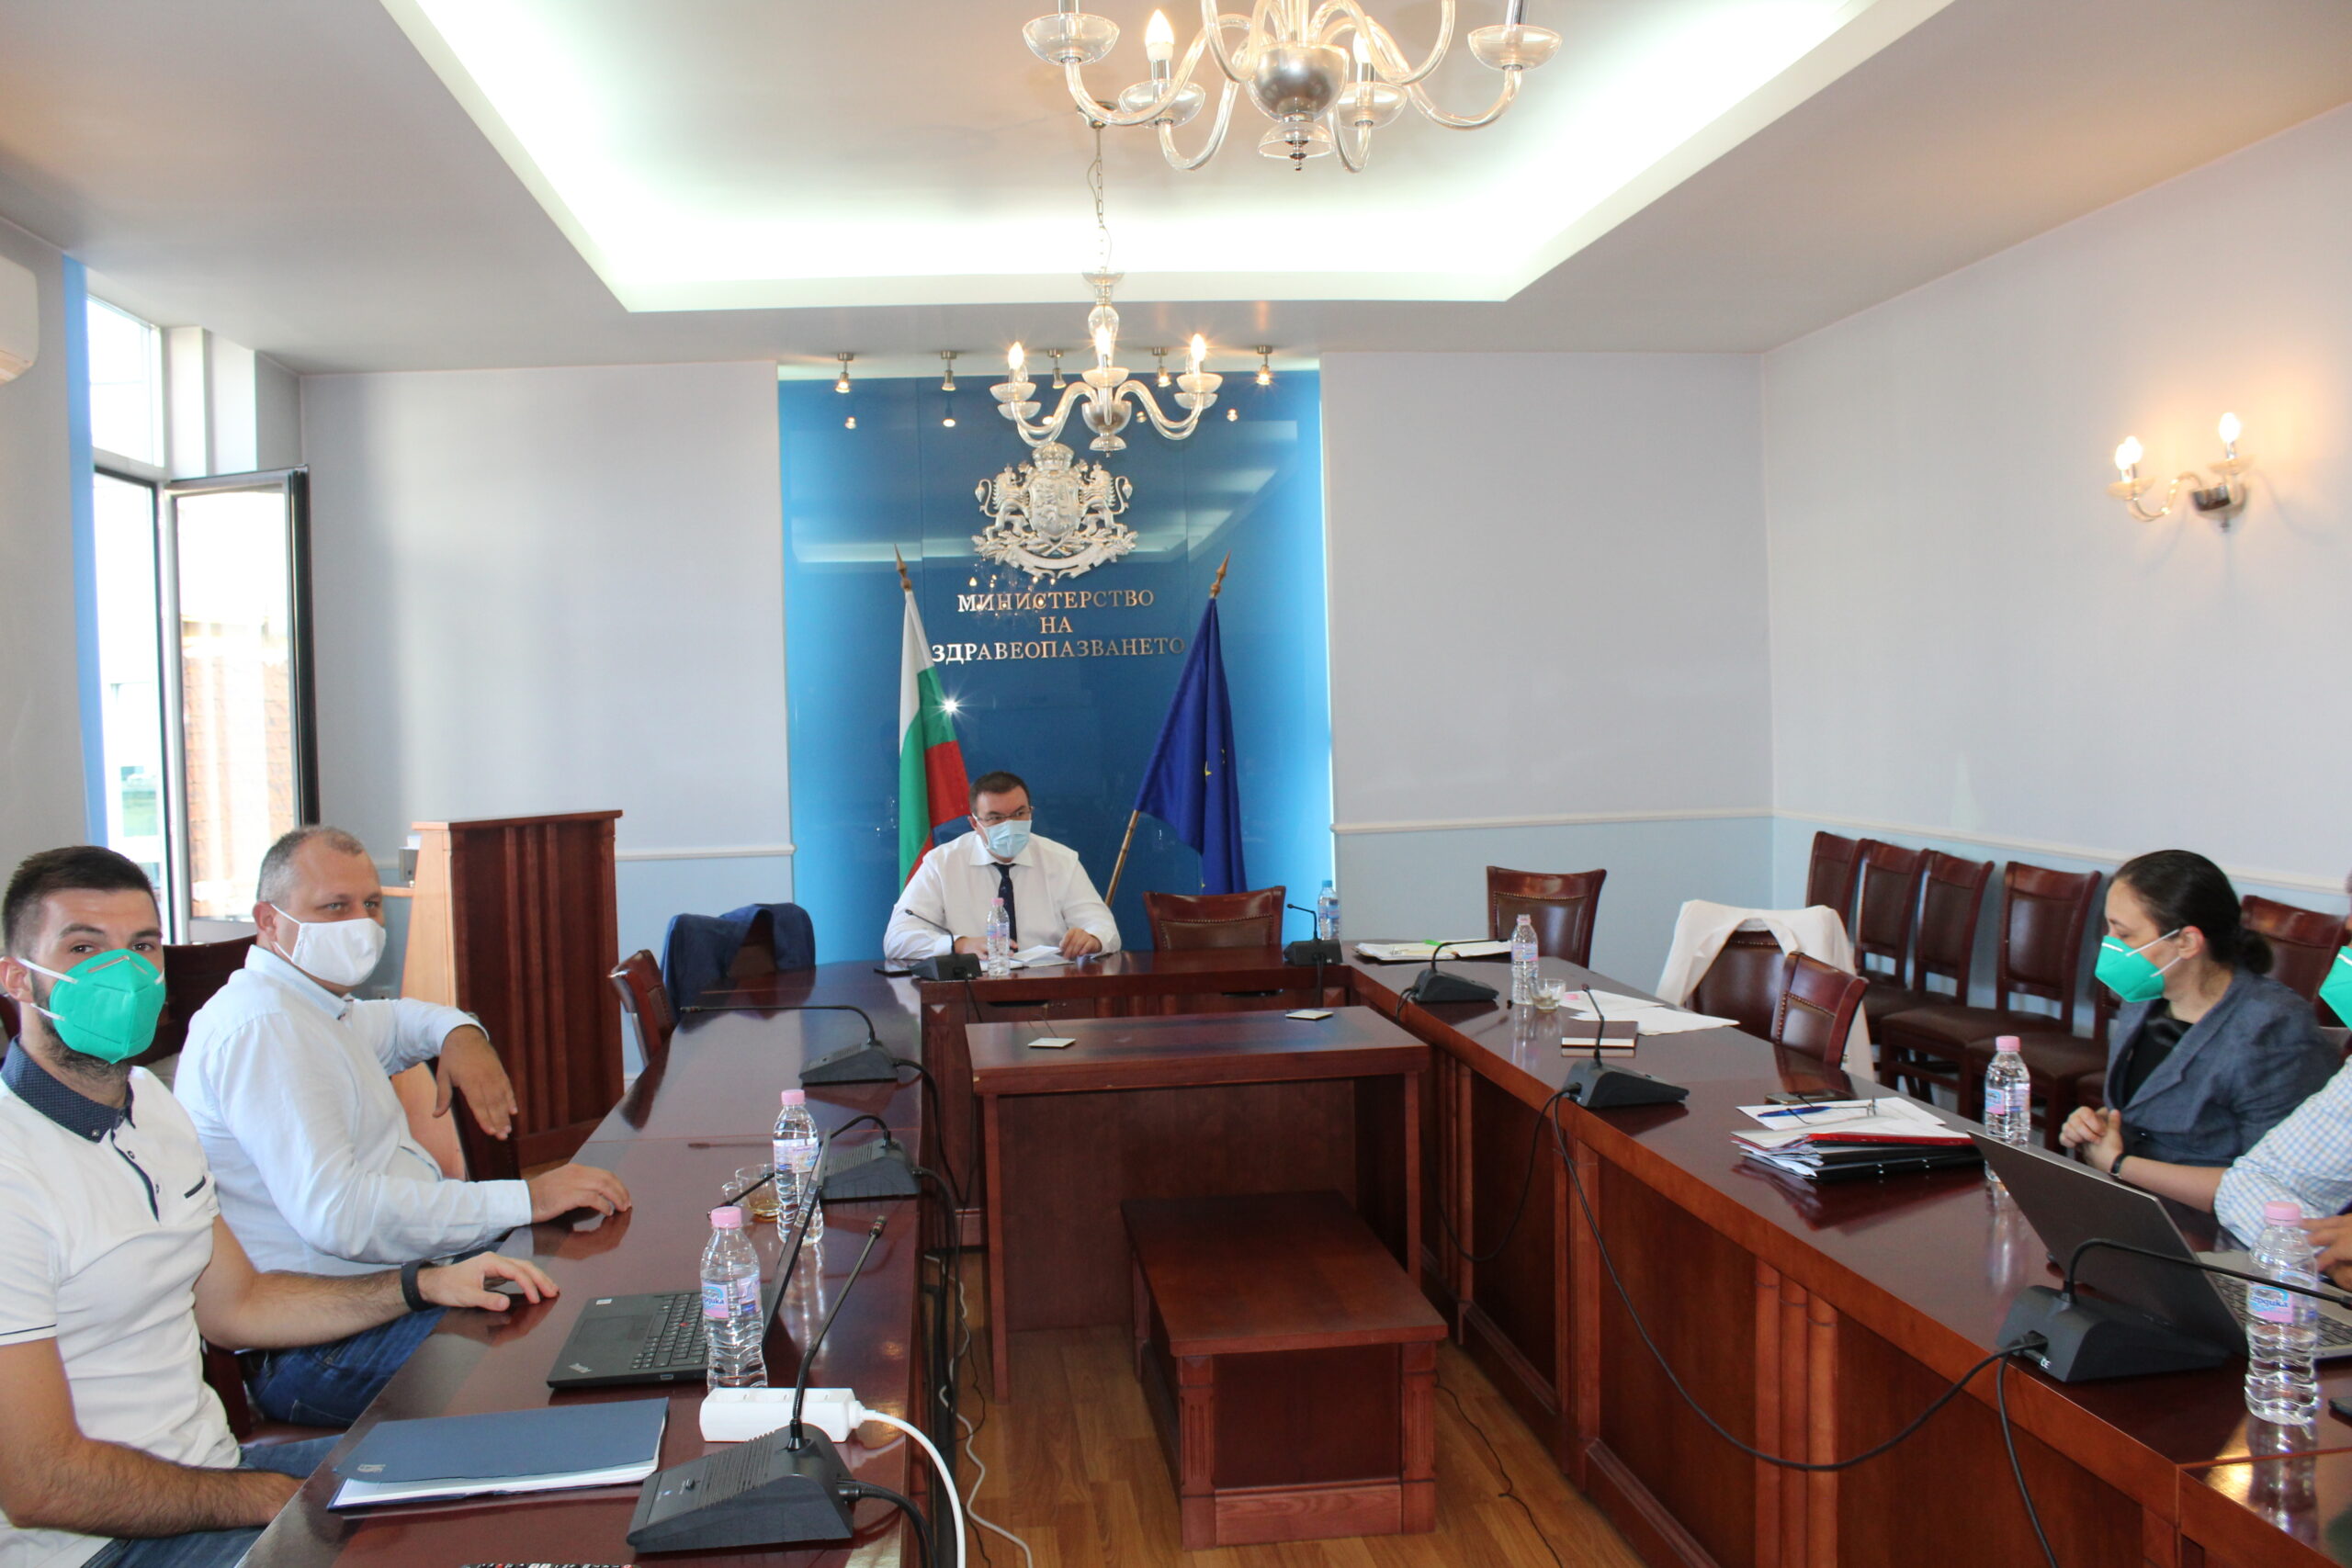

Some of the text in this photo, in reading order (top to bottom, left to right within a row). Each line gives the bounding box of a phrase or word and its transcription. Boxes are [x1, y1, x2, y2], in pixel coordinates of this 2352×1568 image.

[956, 590, 1155, 613] МИНИСТЕРСТВО
[1040, 616, 1073, 634] НА
[932, 637, 1185, 664] ЗДРАВЕОПАЗВАНЕТО
